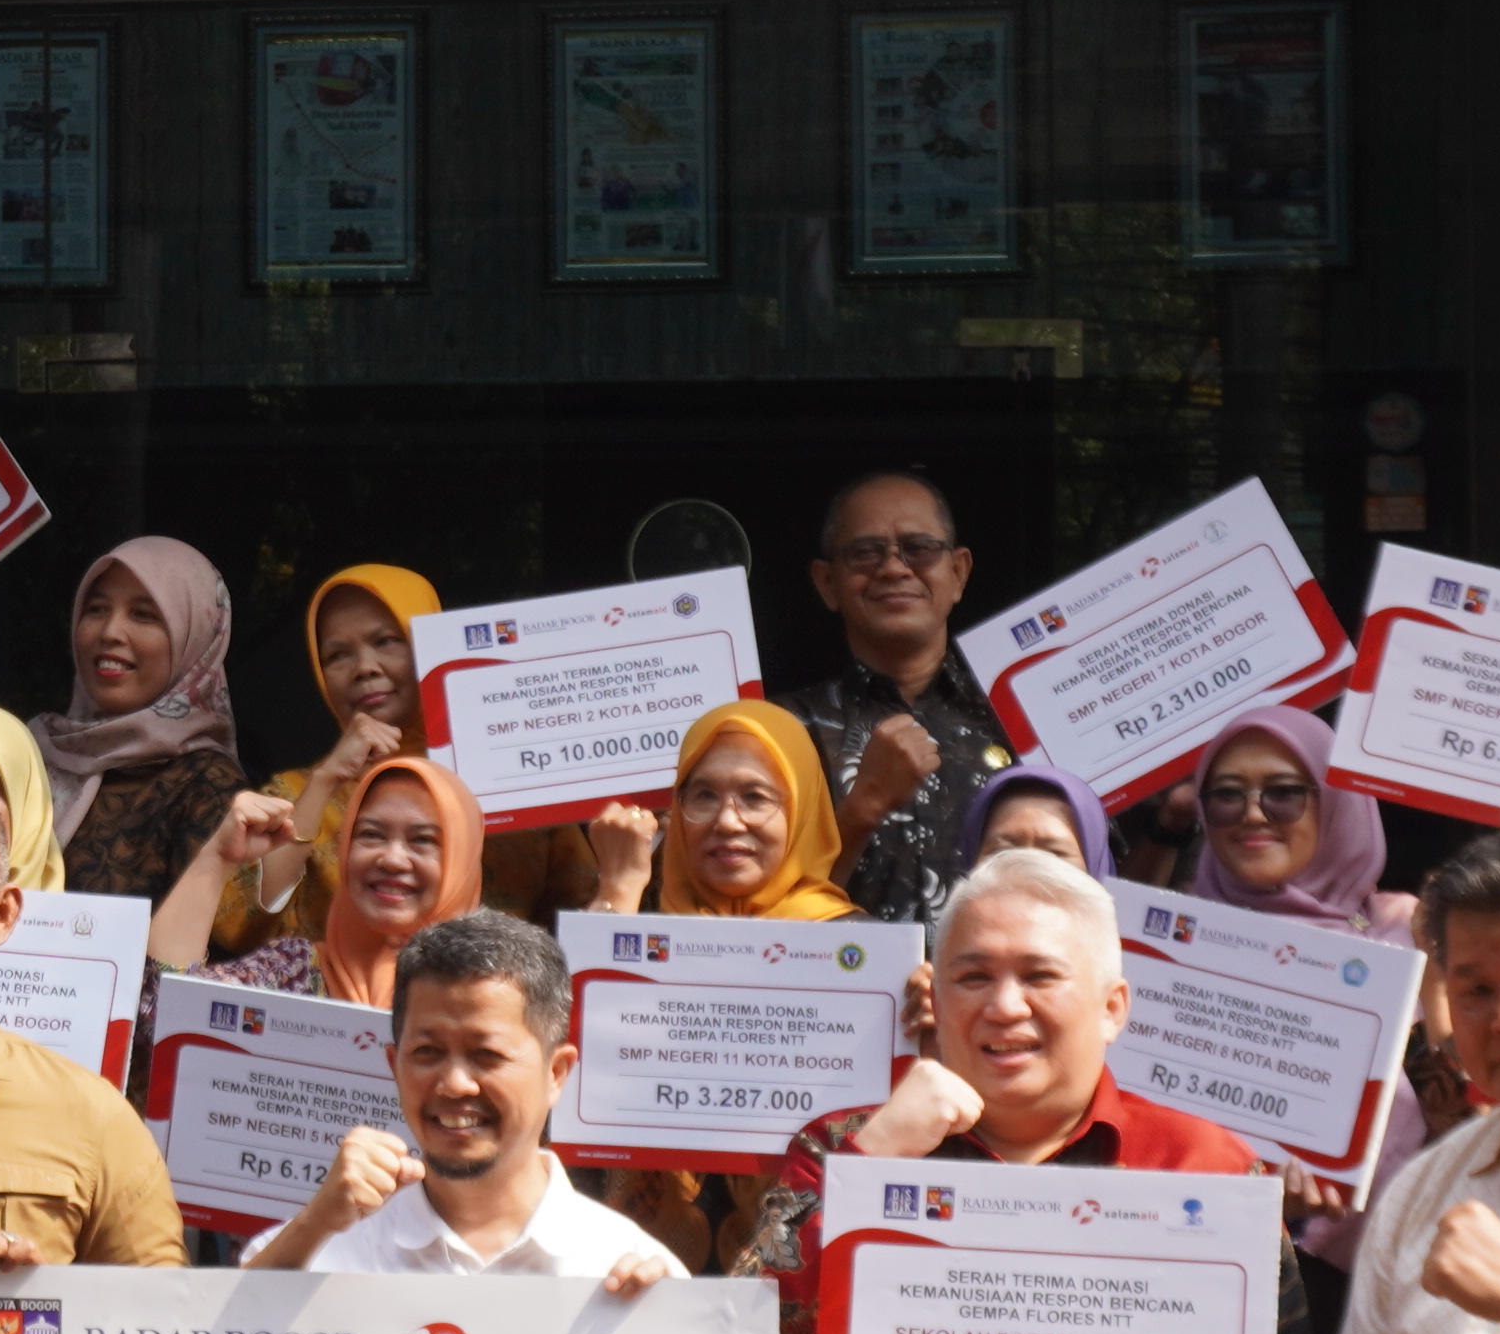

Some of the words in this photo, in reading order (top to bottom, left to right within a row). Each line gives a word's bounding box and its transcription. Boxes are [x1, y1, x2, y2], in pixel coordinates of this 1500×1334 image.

[1067, 700, 1098, 724] SMP
[1100, 670, 1157, 706] NEGERI
[1157, 664, 1166, 676] 7
[1168, 642, 1212, 671] KOTA
[1211, 611, 1268, 648] BOGOR
[1114, 716, 1148, 740] Rp
[1150, 657, 1252, 722] 2.310.000
[487, 721, 519, 736] SMP
[523, 711, 582, 731] NEGERI
[586, 710, 595, 722] 2
[599, 703, 643, 720] KOTA
[646, 693, 704, 713] BOGOR
[520, 750, 552, 771] Rp
[560, 729, 680, 762] 10.000.000
[13, 983, 77, 998] BENCANA
[14, 1015, 72, 1032] BOGOR
[619, 1047, 653, 1061] SMP
[657, 1049, 718, 1065] NEGERI
[723, 1052, 738, 1065] 11
[744, 1053, 789, 1068] KOTA
[794, 1055, 854, 1071] BOGOR
[1127, 1020, 1160, 1039] SMP
[1161, 1029, 1218, 1055] NEGERI
[1219, 1045, 1230, 1059] 8
[1231, 1047, 1273, 1070] KOTA
[1276, 1059, 1332, 1086] BOGOR
[656, 1083, 690, 1110] Rp
[698, 1086, 813, 1112] 3.287.000
[1150, 1062, 1181, 1093] Rp
[1186, 1073, 1288, 1118] 3.400.000
[208, 1111, 242, 1128] SMP
[246, 1117, 307, 1141] NEGERI
[310, 1129, 319, 1143] 5
[240, 1151, 272, 1179] Rp
[279, 1159, 328, 1186] 6.12
[962, 1197, 1010, 1211] RADAR
[1013, 1199, 1062, 1213] BOGOR
[947, 1269, 1006, 1286] SERAH
[1012, 1273, 1077, 1290] TERIMA
[1082, 1277, 1149, 1295] DONASI
[899, 1284, 1027, 1304] KEMANUSIAAN
[1032, 1291, 1104, 1309] RESPON
[1109, 1296, 1195, 1314] BENCANA
[958, 1304, 1021, 1321] GEMPA
[1026, 1308, 1095, 1326] FLORES
[1100, 1313, 1134, 1328] NTT
